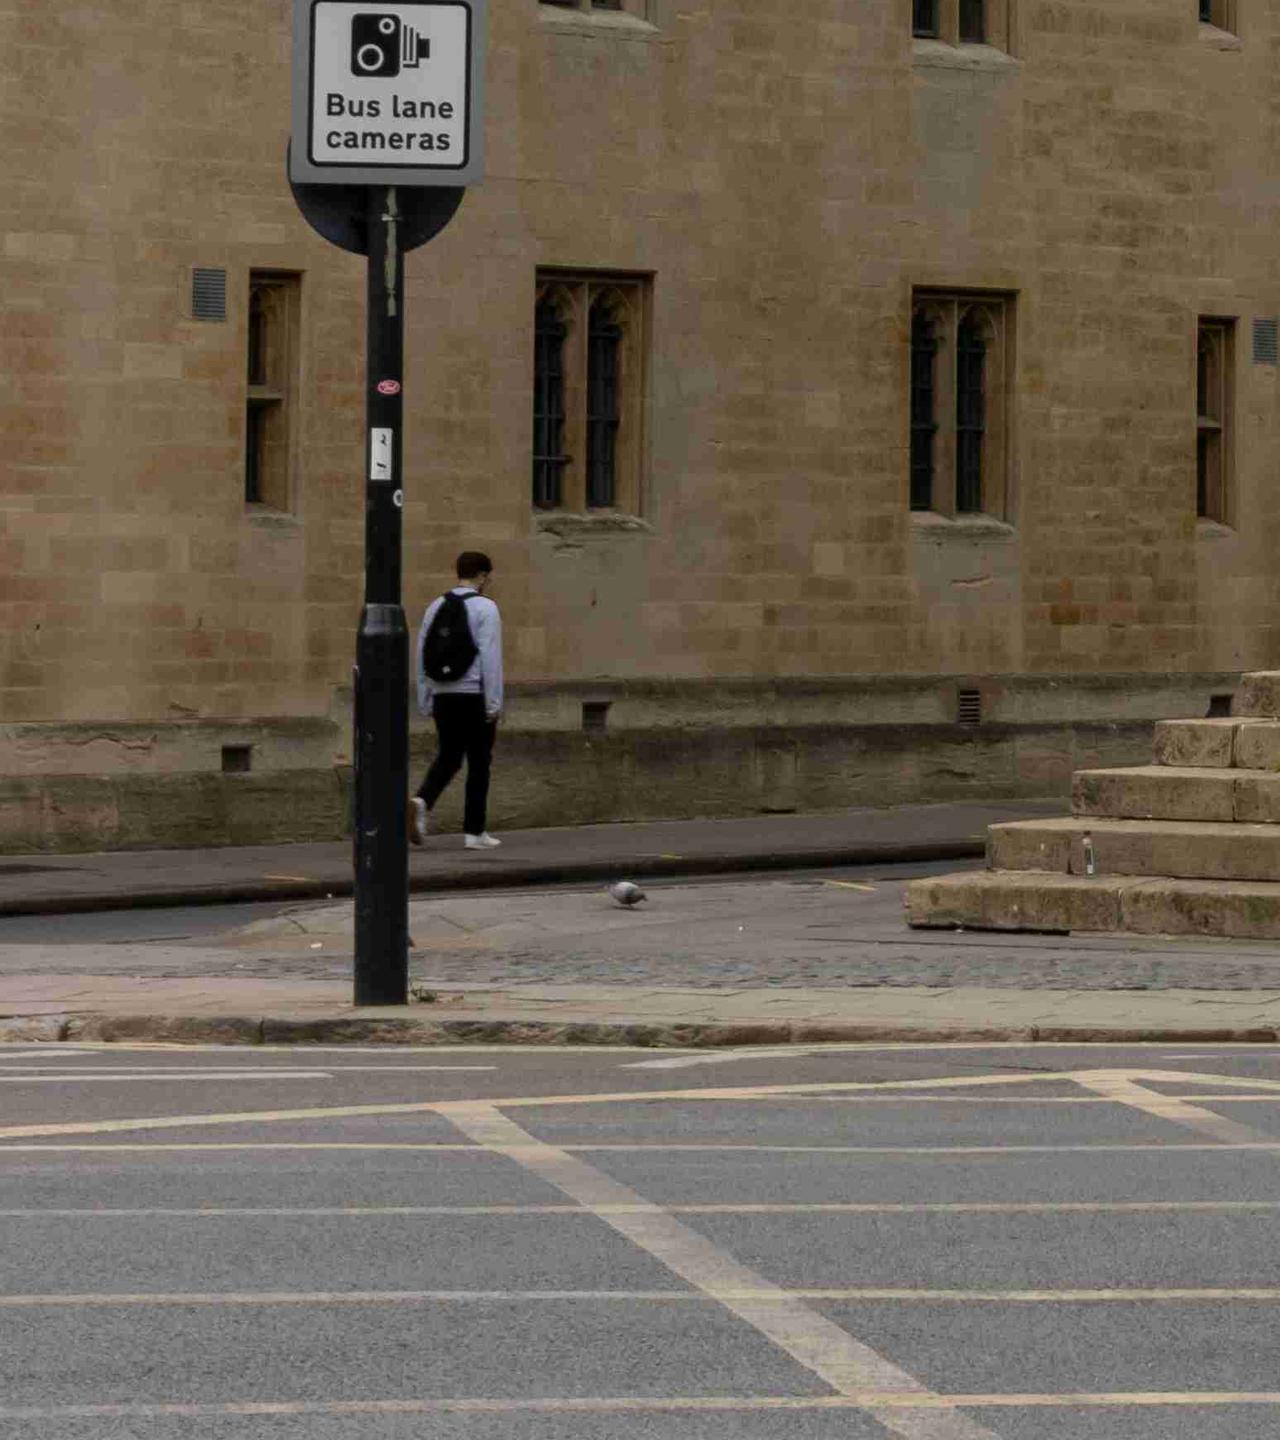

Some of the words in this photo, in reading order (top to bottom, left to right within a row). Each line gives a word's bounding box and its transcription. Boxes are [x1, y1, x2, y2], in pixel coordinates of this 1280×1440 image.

[327, 93, 381, 119] Bus
[393, 94, 454, 119] lane
[326, 130, 451, 151] cameras
